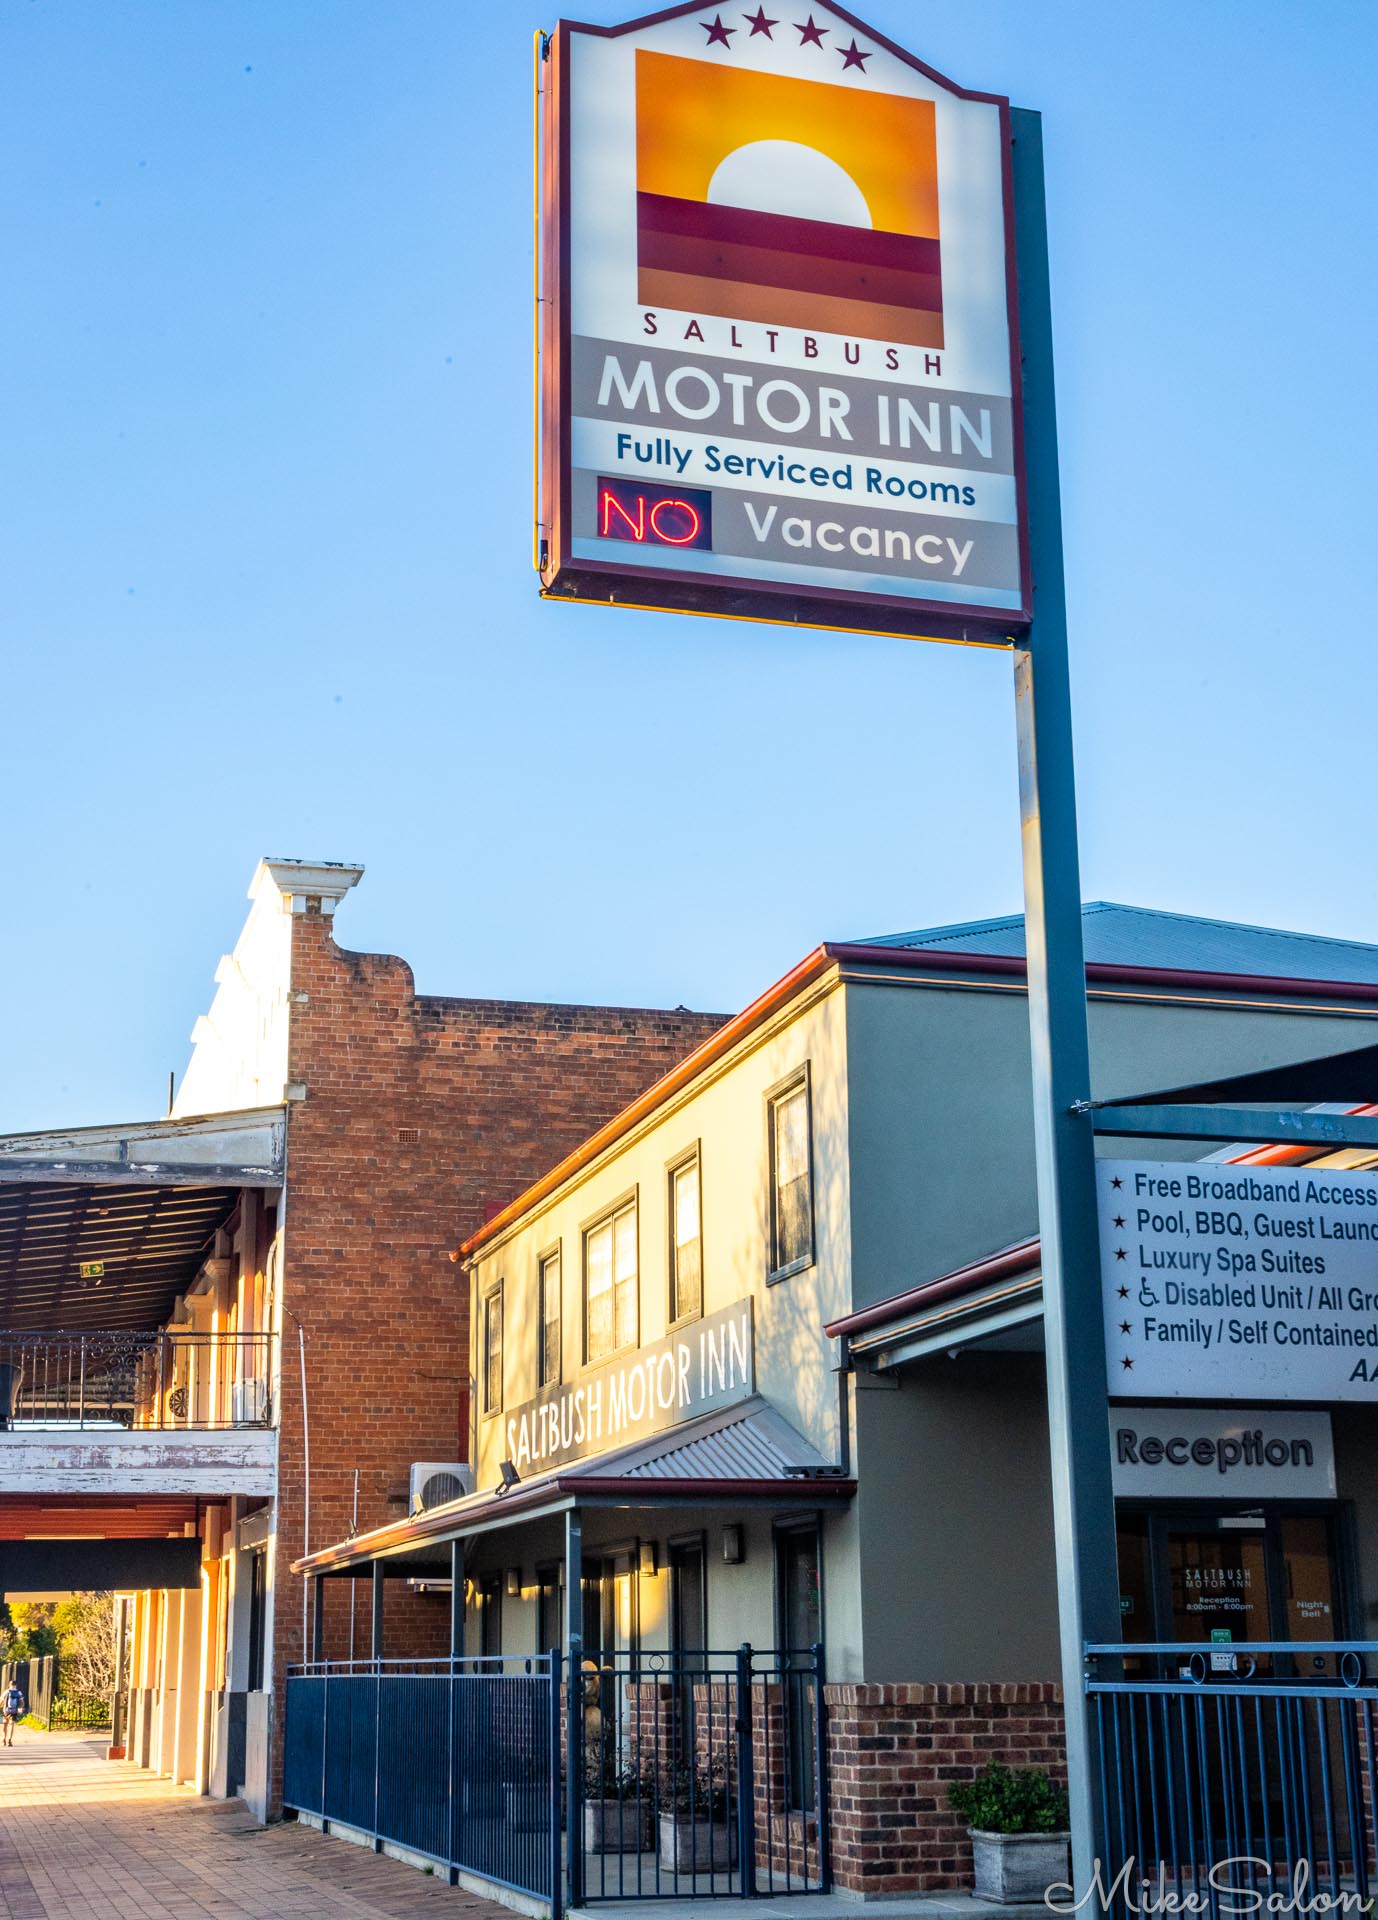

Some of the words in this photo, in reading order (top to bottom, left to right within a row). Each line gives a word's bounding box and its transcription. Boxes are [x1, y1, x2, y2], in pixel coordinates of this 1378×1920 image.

[643, 312, 942, 377] SALTBUSH
[597, 355, 853, 441] MOTOR
[877, 395, 993, 459] INN
[617, 433, 693, 474] Fully
[704, 445, 852, 491] Serviced
[866, 467, 976, 506] Rooms
[600, 489, 699, 545] NO
[744, 502, 975, 577] Vacancy
[1134, 1172, 1181, 1198] Free
[1187, 1175, 1300, 1203] Broadband
[1305, 1180, 1377, 1206] Access
[1137, 1208, 1190, 1238] Pool,
[1196, 1210, 1249, 1240] BBQ,
[1254, 1213, 1315, 1239] Guest
[1139, 1244, 1211, 1276] Luxury
[1217, 1247, 1256, 1277] Spa
[1261, 1248, 1326, 1275] Suites
[1165, 1281, 1255, 1308] Disabled
[1261, 1284, 1304, 1310] Unit
[1318, 1286, 1343, 1311] All
[1144, 1317, 1212, 1349] Family
[1228, 1320, 1268, 1345] Self
[1273, 1320, 1378, 1348] Contained
[507, 1379, 602, 1469] SALTBUSH
[608, 1342, 691, 1435] MOTOR
[699, 1312, 748, 1400] INN
[1116, 1428, 1314, 1474] Reception
[1185, 1568, 1251, 1580] SALTBUSH
[1185, 1580, 1227, 1588] MOTOR
[1232, 1580, 1252, 1588] INN
[1199, 1596, 1240, 1605] Reception
[1296, 1601, 1324, 1610] Night
[1301, 1609, 1321, 1617] Bell
